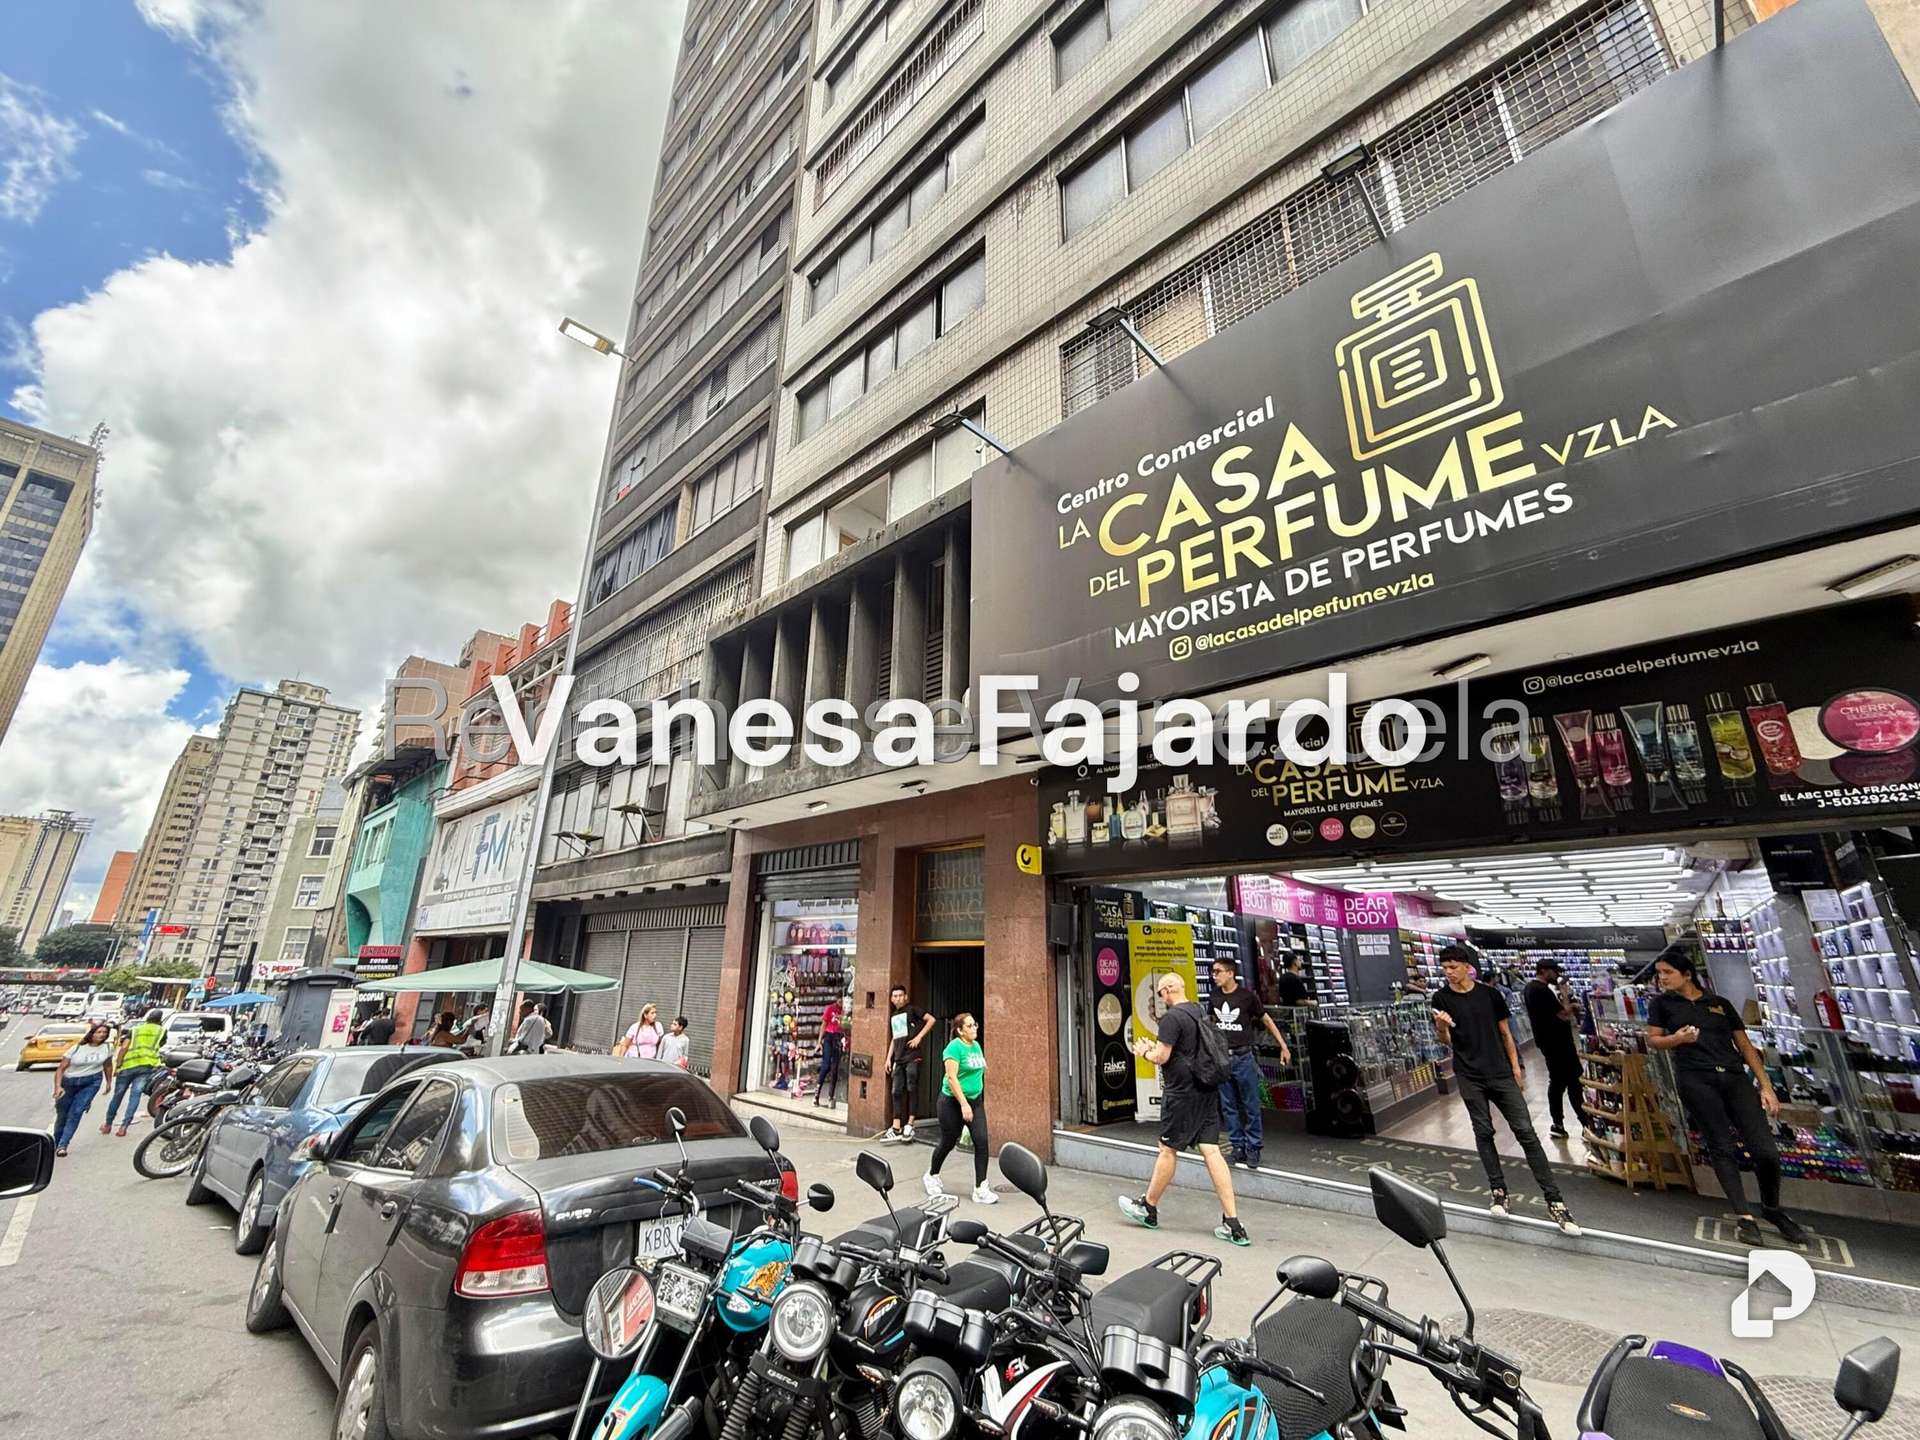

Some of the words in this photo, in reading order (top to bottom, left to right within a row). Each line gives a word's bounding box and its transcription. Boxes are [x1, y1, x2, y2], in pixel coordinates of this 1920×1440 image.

[1057, 472, 1129, 514] Centro
[1136, 395, 1275, 478] Comercial
[1058, 517, 1092, 550] LA
[1098, 421, 1337, 557] CASA
[1089, 567, 1130, 597] DEL
[1136, 410, 1537, 608] PERFUME
[1540, 405, 1678, 466] VZLA
[1114, 580, 1276, 648] MAYORISTA
[1285, 558, 1332, 596] DE
[1342, 482, 1573, 579] PERFUMES
[1195, 571, 1435, 651] @lacasadelperfumevzla
[1545, 640, 1760, 687] @lacasadelperfumevzla
[1841, 703, 1897, 714] CHERRY
[1235, 764, 1252, 775] LA
[1251, 787, 1269, 798] DEL
[1272, 768, 1408, 806] PERFUME
[1409, 777, 1444, 790] VZLA
[1780, 793, 1794, 801] EL
[1797, 791, 1821, 800] ABC
[1825, 789, 1841, 797] DE
[1844, 787, 1860, 795] LA
[1283, 805, 1326, 817] MAYORISTA
[1328, 803, 1338, 811] DE
[1340, 799, 1384, 810] PERFUMES
[1101, 905, 1123, 917] CASA
[1344, 897, 1388, 911] DEAR
[1346, 911, 1389, 925] BODY
[1100, 968, 1118, 976] BODY
